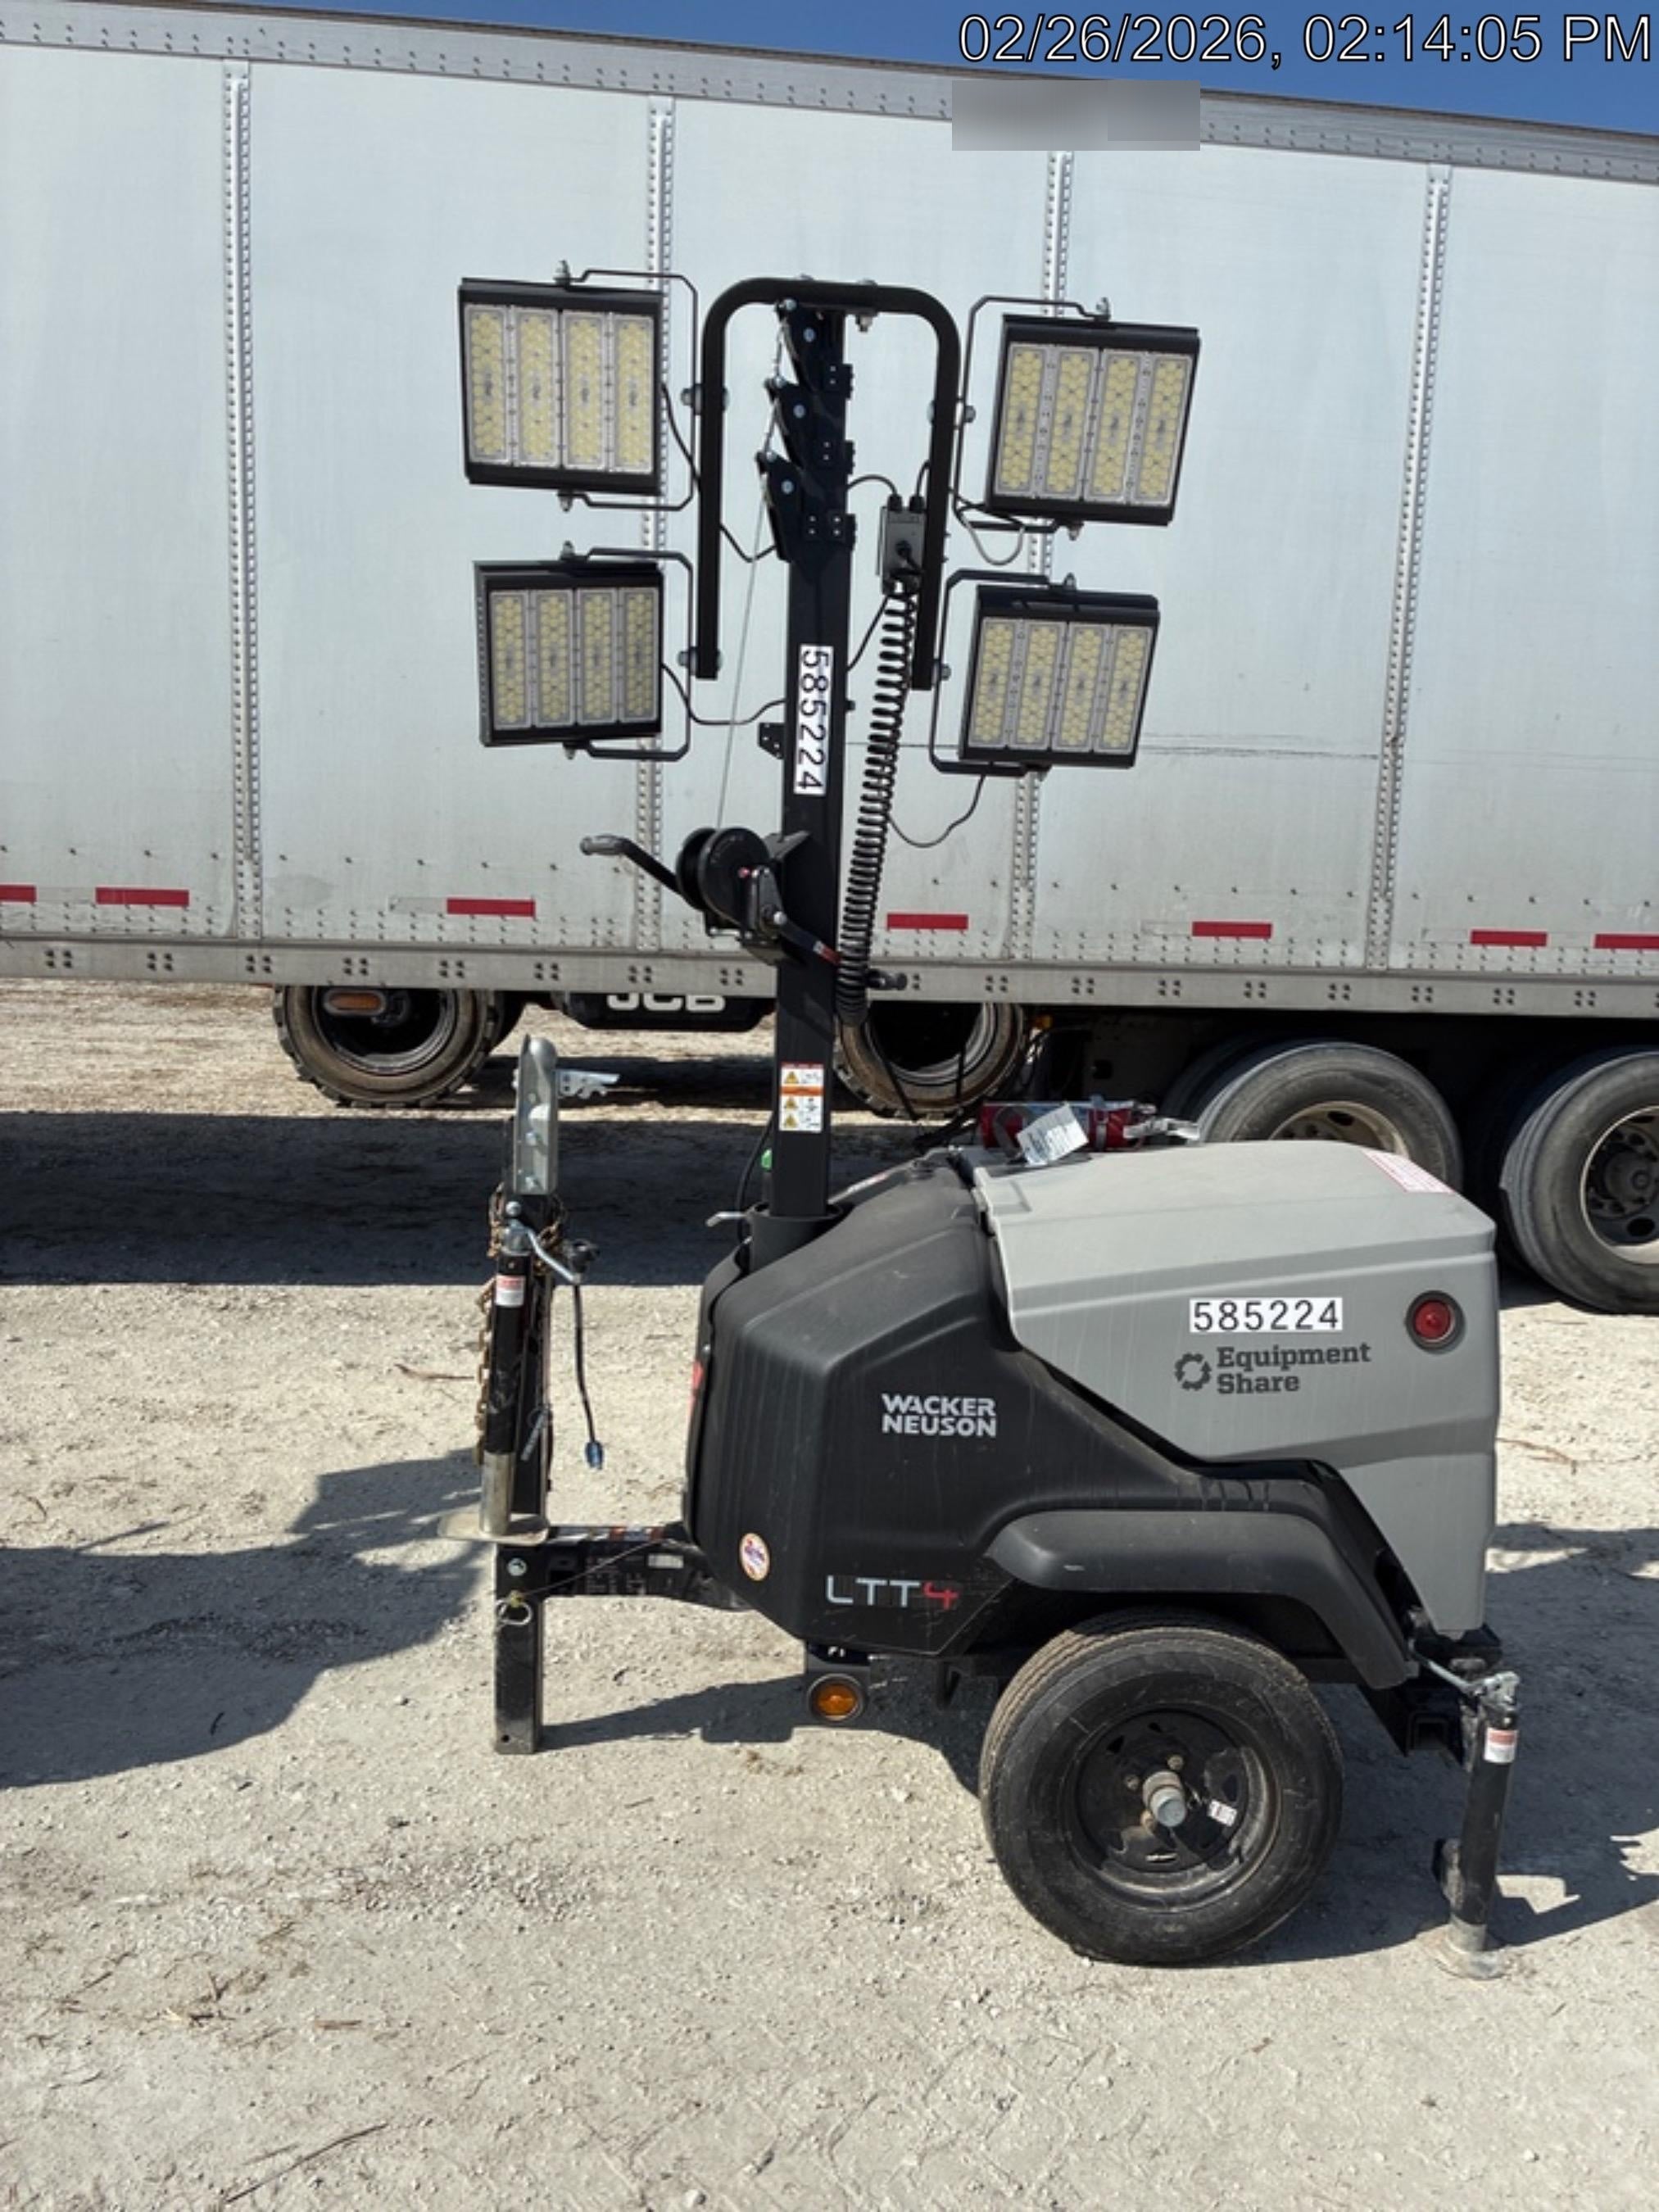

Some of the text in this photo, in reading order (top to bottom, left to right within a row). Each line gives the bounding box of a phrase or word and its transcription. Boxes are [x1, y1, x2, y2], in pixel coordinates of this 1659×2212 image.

[798, 650, 830, 789] 585224
[1193, 1299, 1339, 1331] 585224
[1217, 1342, 1371, 1372] Equipment
[1217, 1372, 1300, 1394] Share
[881, 1393, 997, 1416] WACKER
[881, 1413, 997, 1437] NEUSON
[826, 1574, 959, 1611] LTT4
